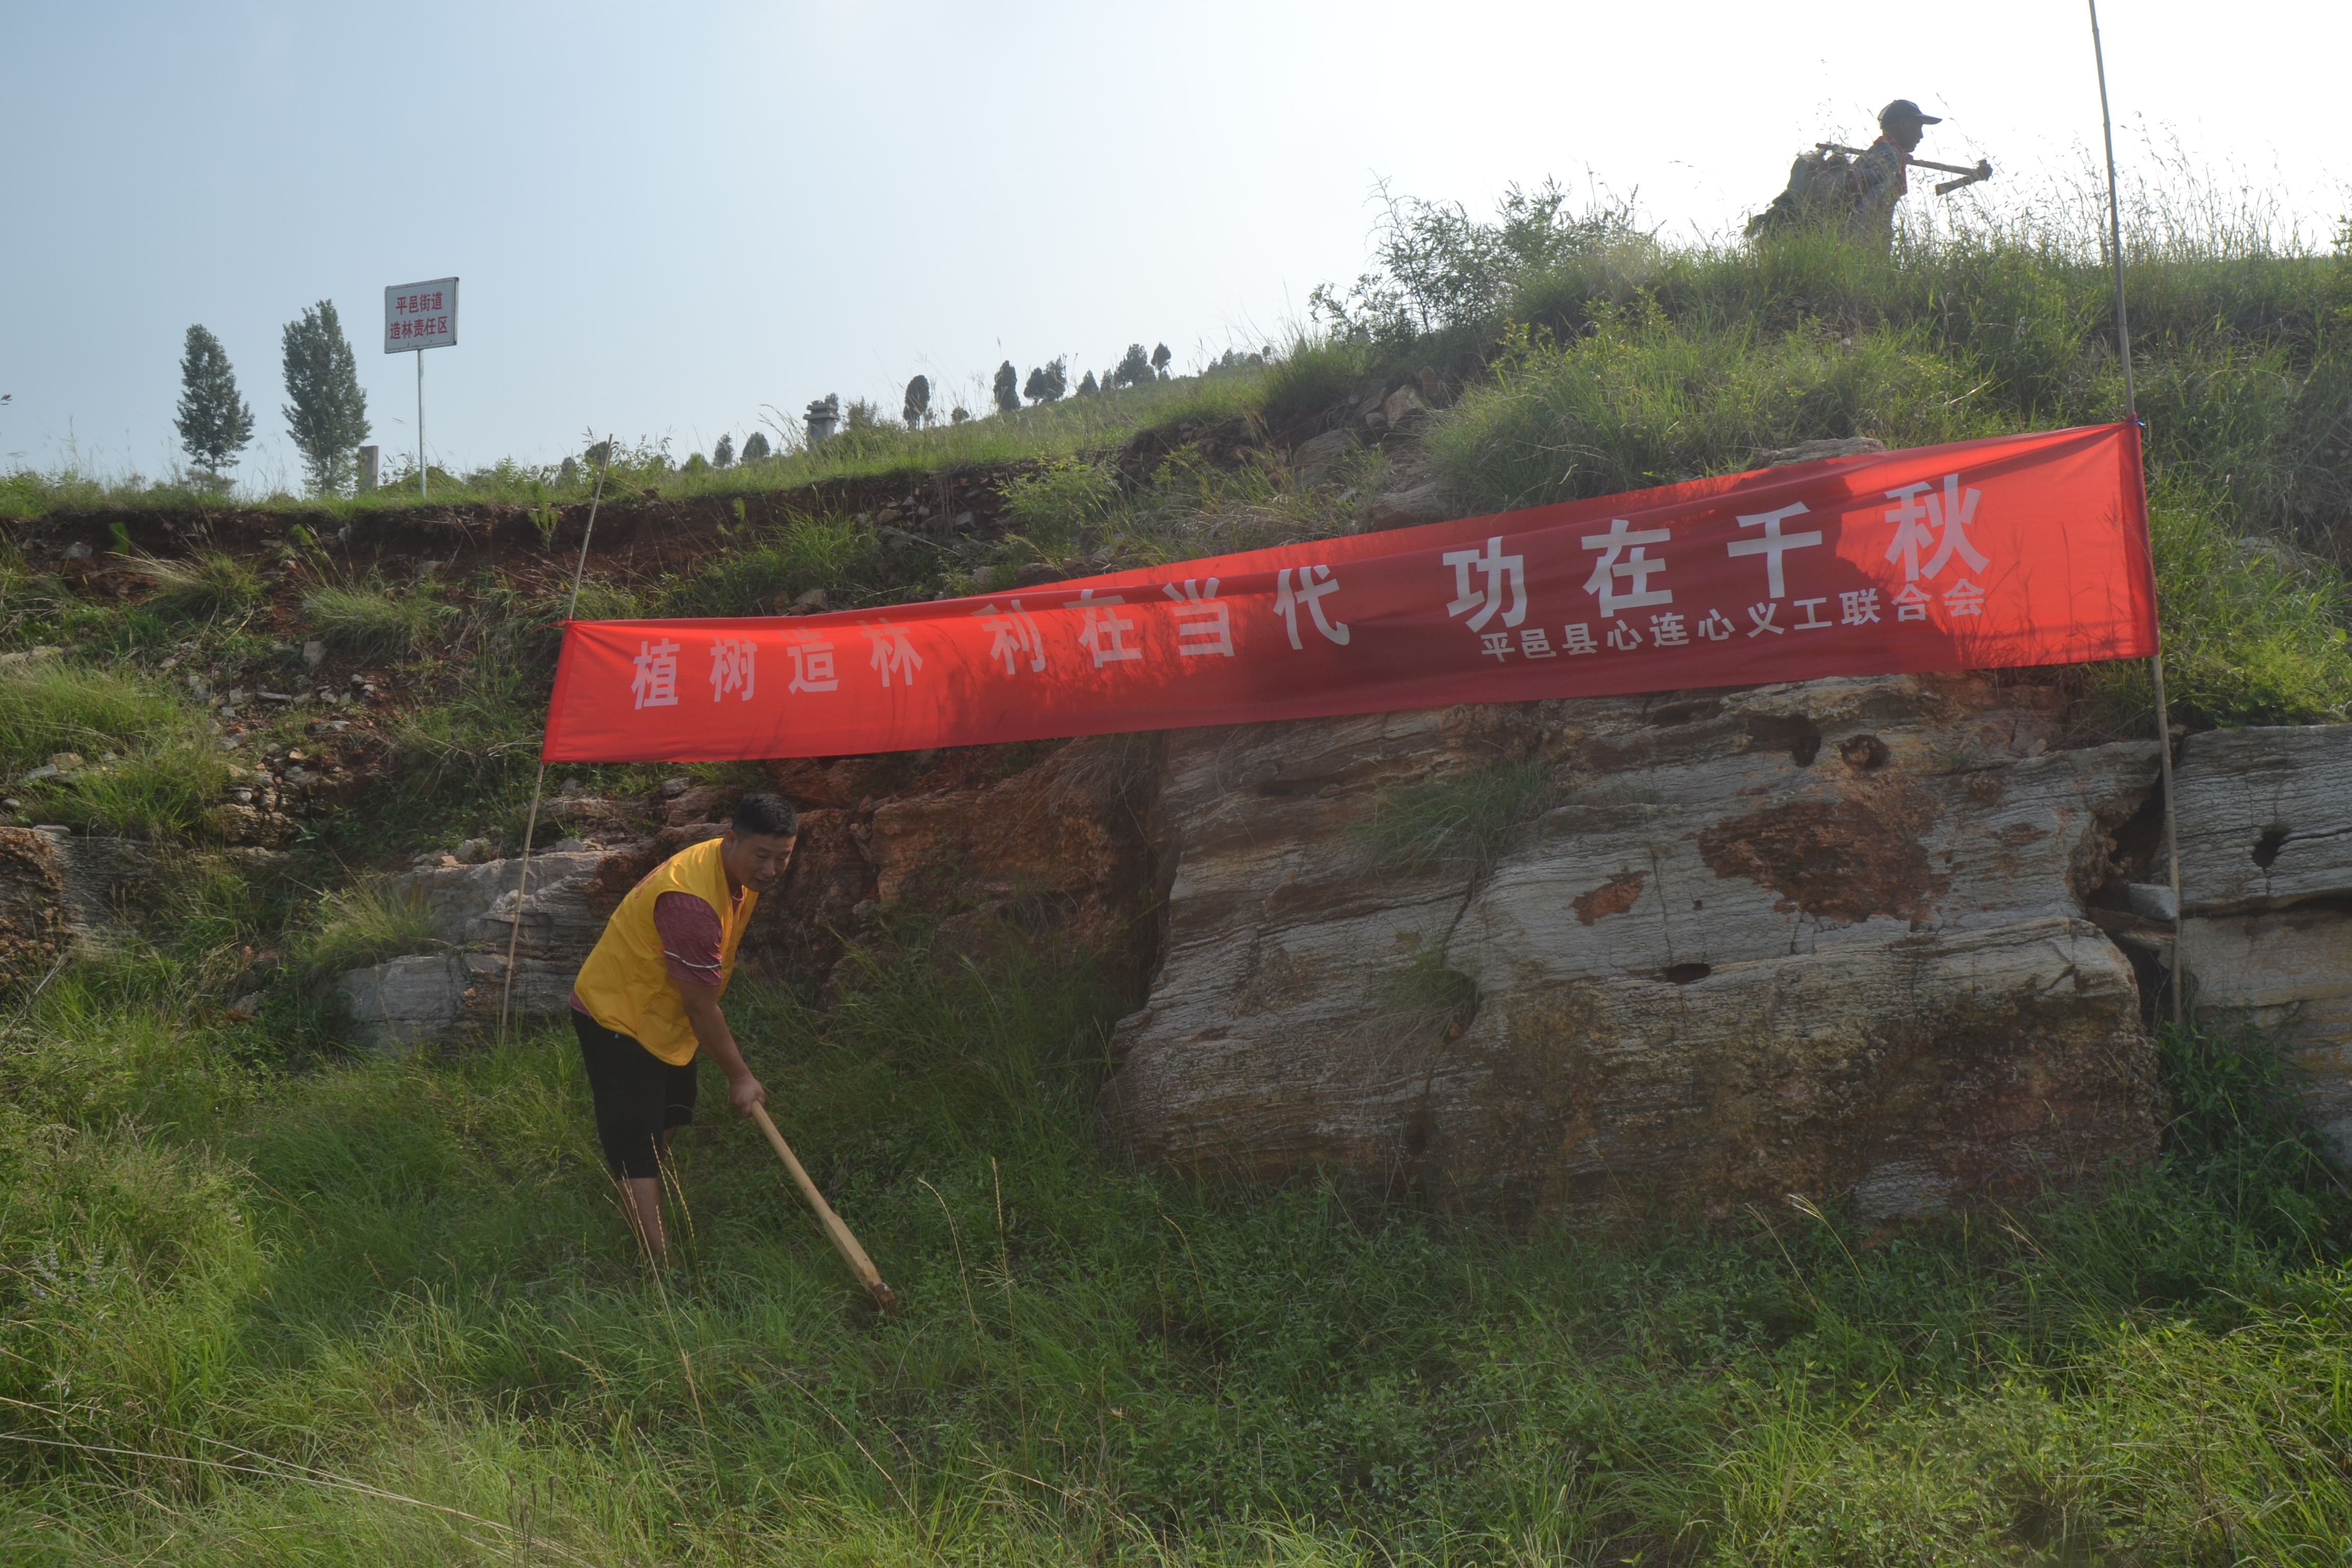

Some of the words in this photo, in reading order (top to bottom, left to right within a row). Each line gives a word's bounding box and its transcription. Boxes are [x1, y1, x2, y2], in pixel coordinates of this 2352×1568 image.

[390, 316, 448, 339] 造林责任区
[396, 291, 443, 315] 平邑街道
[631, 618, 923, 710] 植树造林
[971, 565, 1350, 675] 利在当代
[1443, 473, 1990, 633] 功在千秋
[1481, 579, 1987, 663] 平邑县心连心义工联合会
